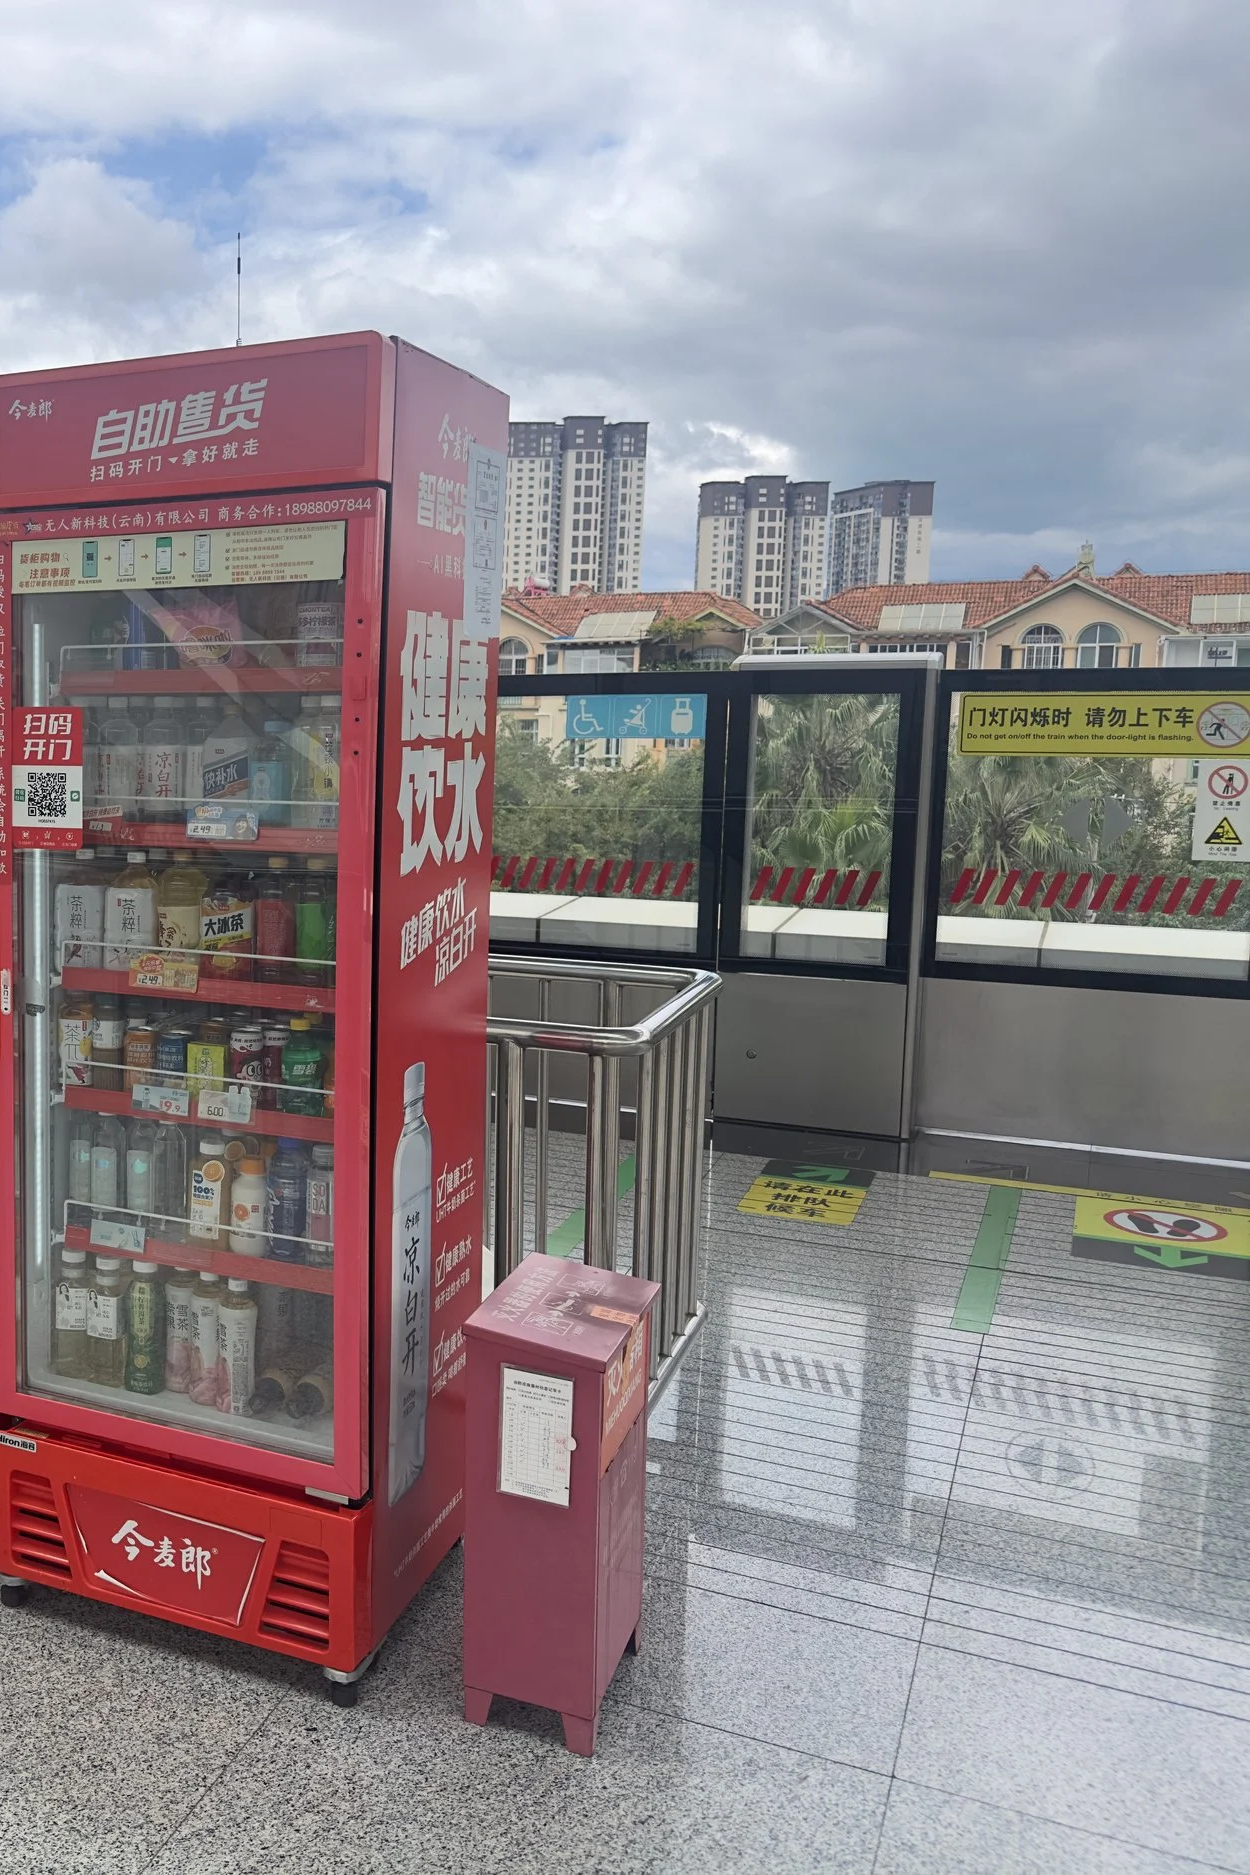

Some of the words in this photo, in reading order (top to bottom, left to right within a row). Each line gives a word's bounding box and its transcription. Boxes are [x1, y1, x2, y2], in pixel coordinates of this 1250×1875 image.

[8, 398, 54, 423] 今麦郎
[90, 378, 269, 460] 自助售货
[89, 455, 162, 482] 扫码开门
[181, 438, 260, 467] 拿好就走
[44, 506, 210, 532] 无人新科技(云南)有限公司
[217, 496, 373, 523] 商务合作:18988097844
[19, 552, 61, 565] 货柜购物
[29, 567, 71, 580] 注意事项
[400, 609, 489, 741] 健康
[23, 713, 73, 735] 扫码
[968, 706, 1072, 728] 门灯闪烁时
[1085, 706, 1195, 728] 请勿上下车
[23, 738, 72, 761] 开门
[154, 752, 173, 798] 凉白开
[397, 742, 486, 878] 饮水
[69, 895, 84, 930] 茶粹
[121, 898, 136, 934] 茶粹
[204, 912, 245, 937] 大冰茶
[400, 877, 467, 970] 健康饮水
[434, 907, 478, 988] 凉白开
[446, 1157, 474, 1195] 健康工艺
[763, 1180, 854, 1199] 请在此
[764, 1203, 827, 1218] 候车
[772, 1192, 831, 1208] 排队
[111, 1519, 212, 1591] 今麦郎
